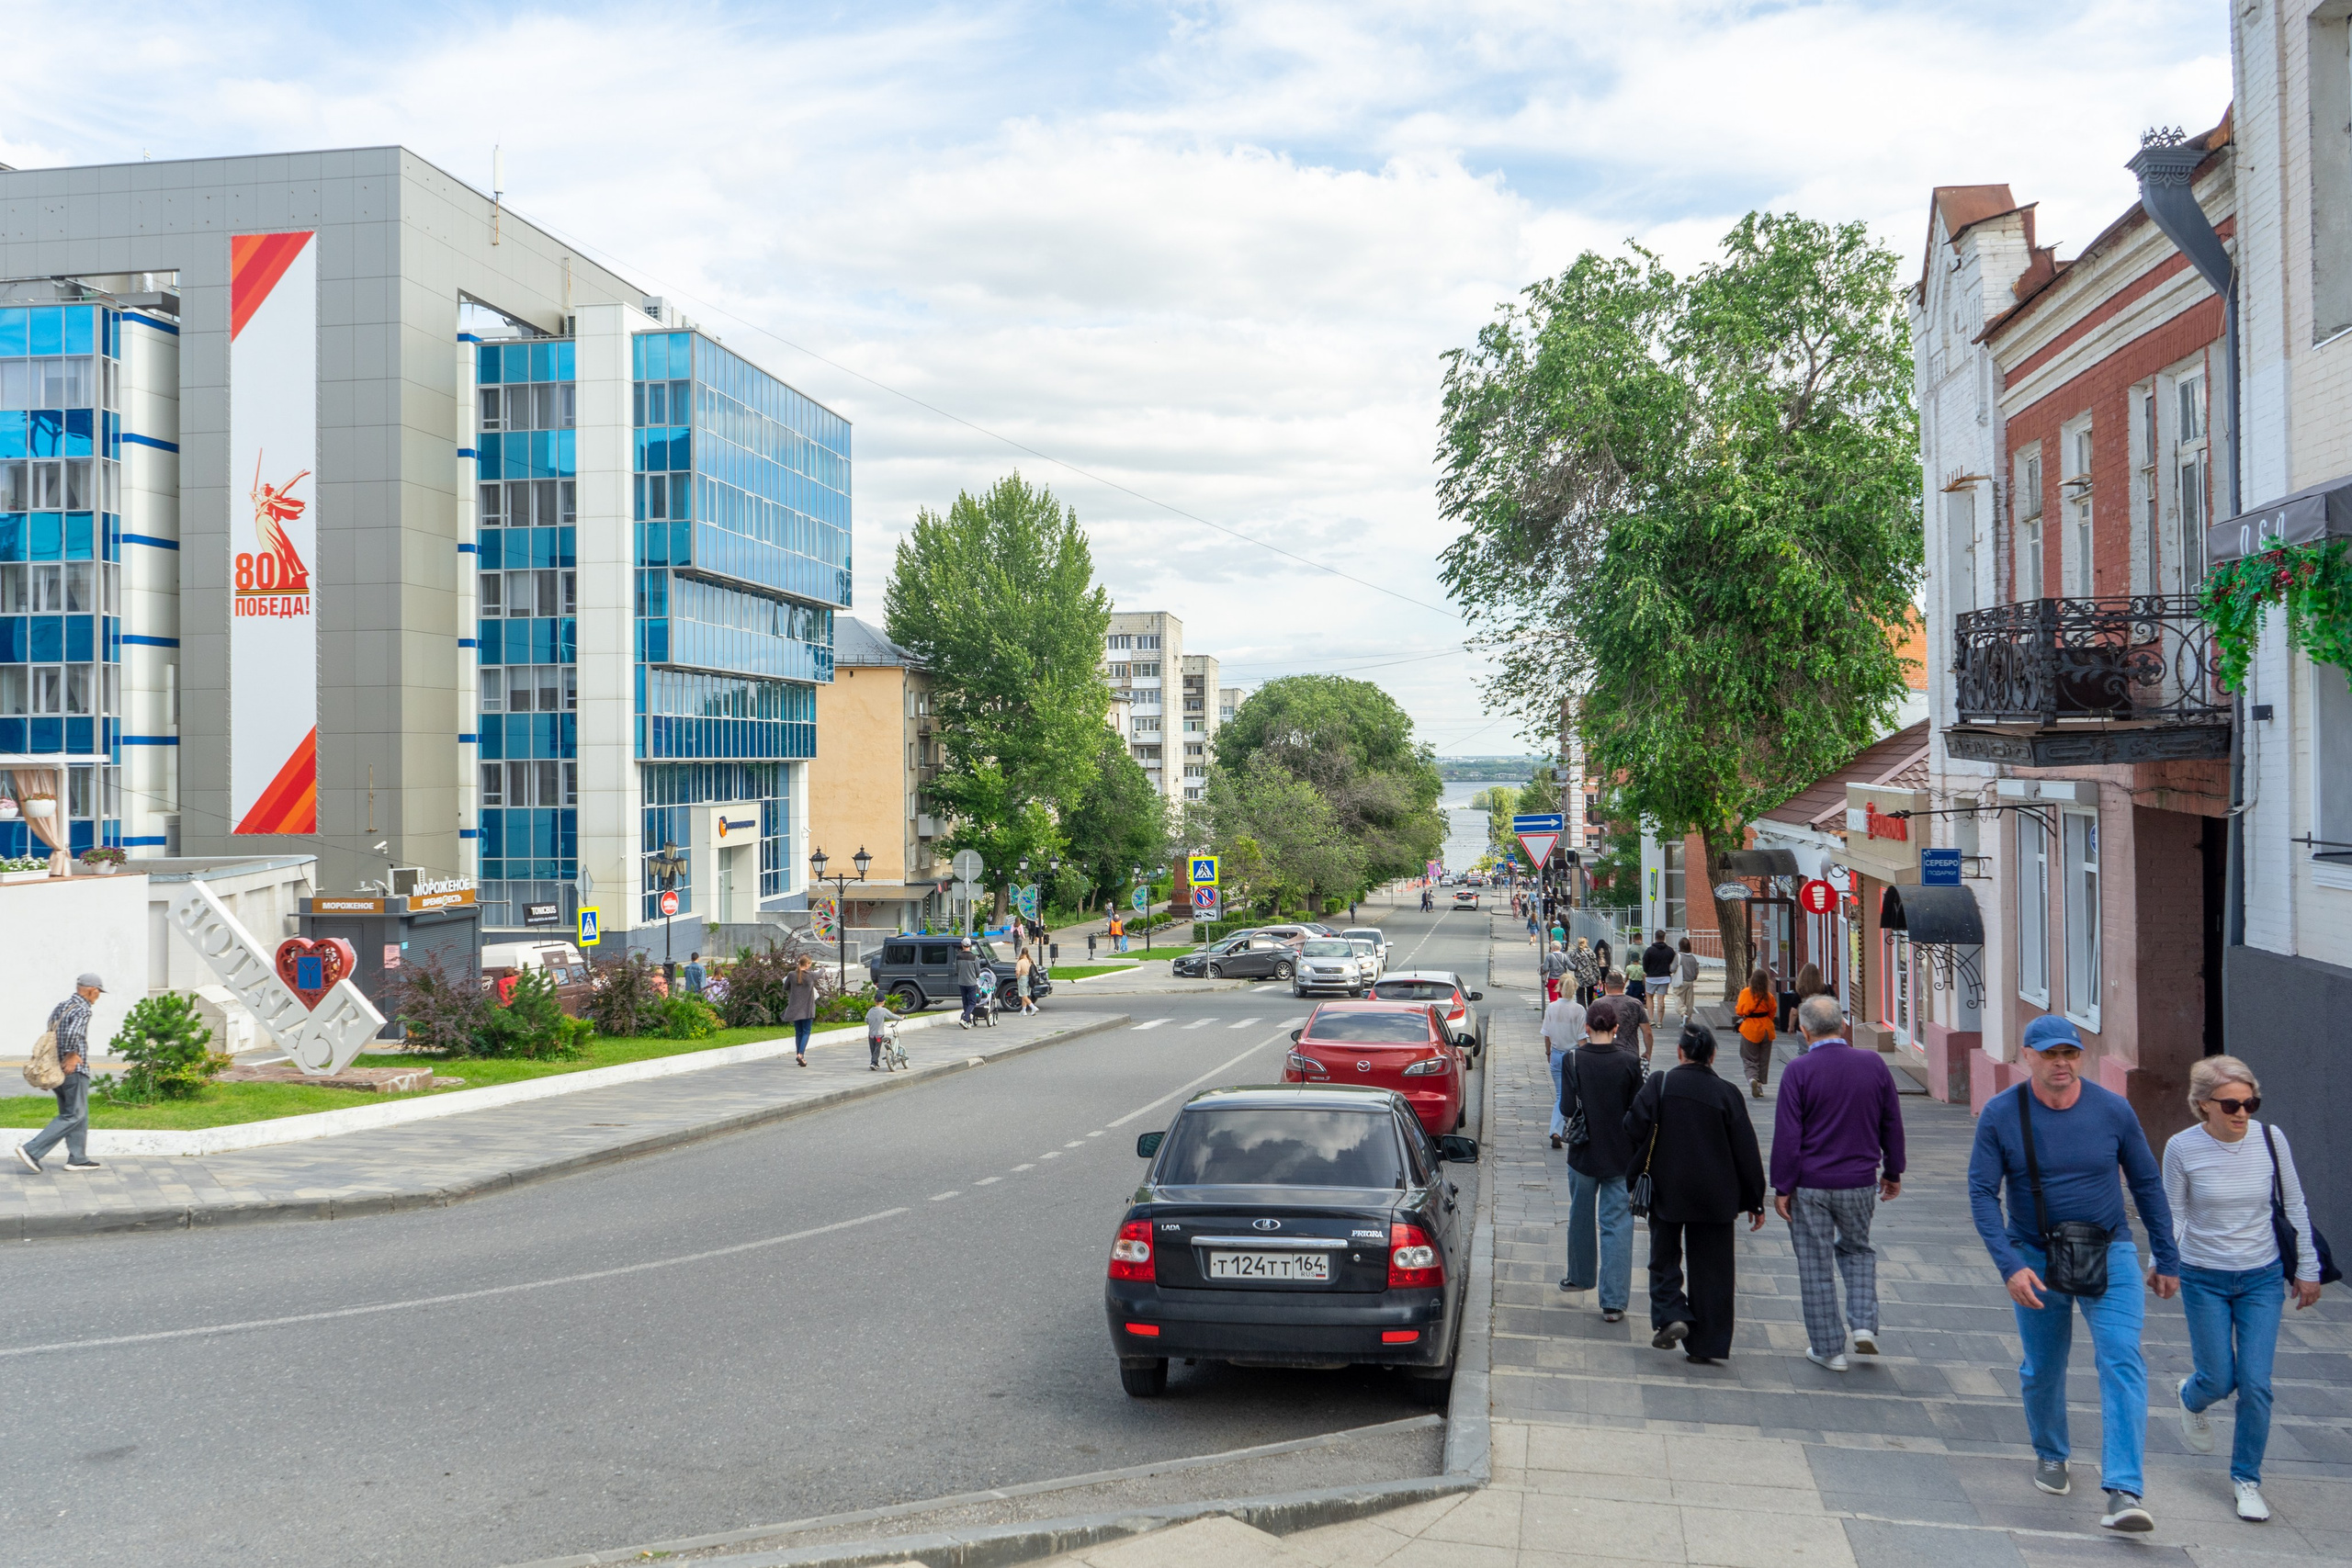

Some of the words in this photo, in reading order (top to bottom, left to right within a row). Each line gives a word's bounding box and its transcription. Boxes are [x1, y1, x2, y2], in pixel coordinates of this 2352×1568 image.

[235, 552, 275, 590] 80
[235, 597, 310, 618] ПОБЕДА!
[1925, 859, 1959, 867] СЕРЕБРО
[413, 878, 470, 897] МОРОЖЕНОЕ
[1351, 1229, 1384, 1238] PRIORA
[1295, 1256, 1323, 1271] 164
